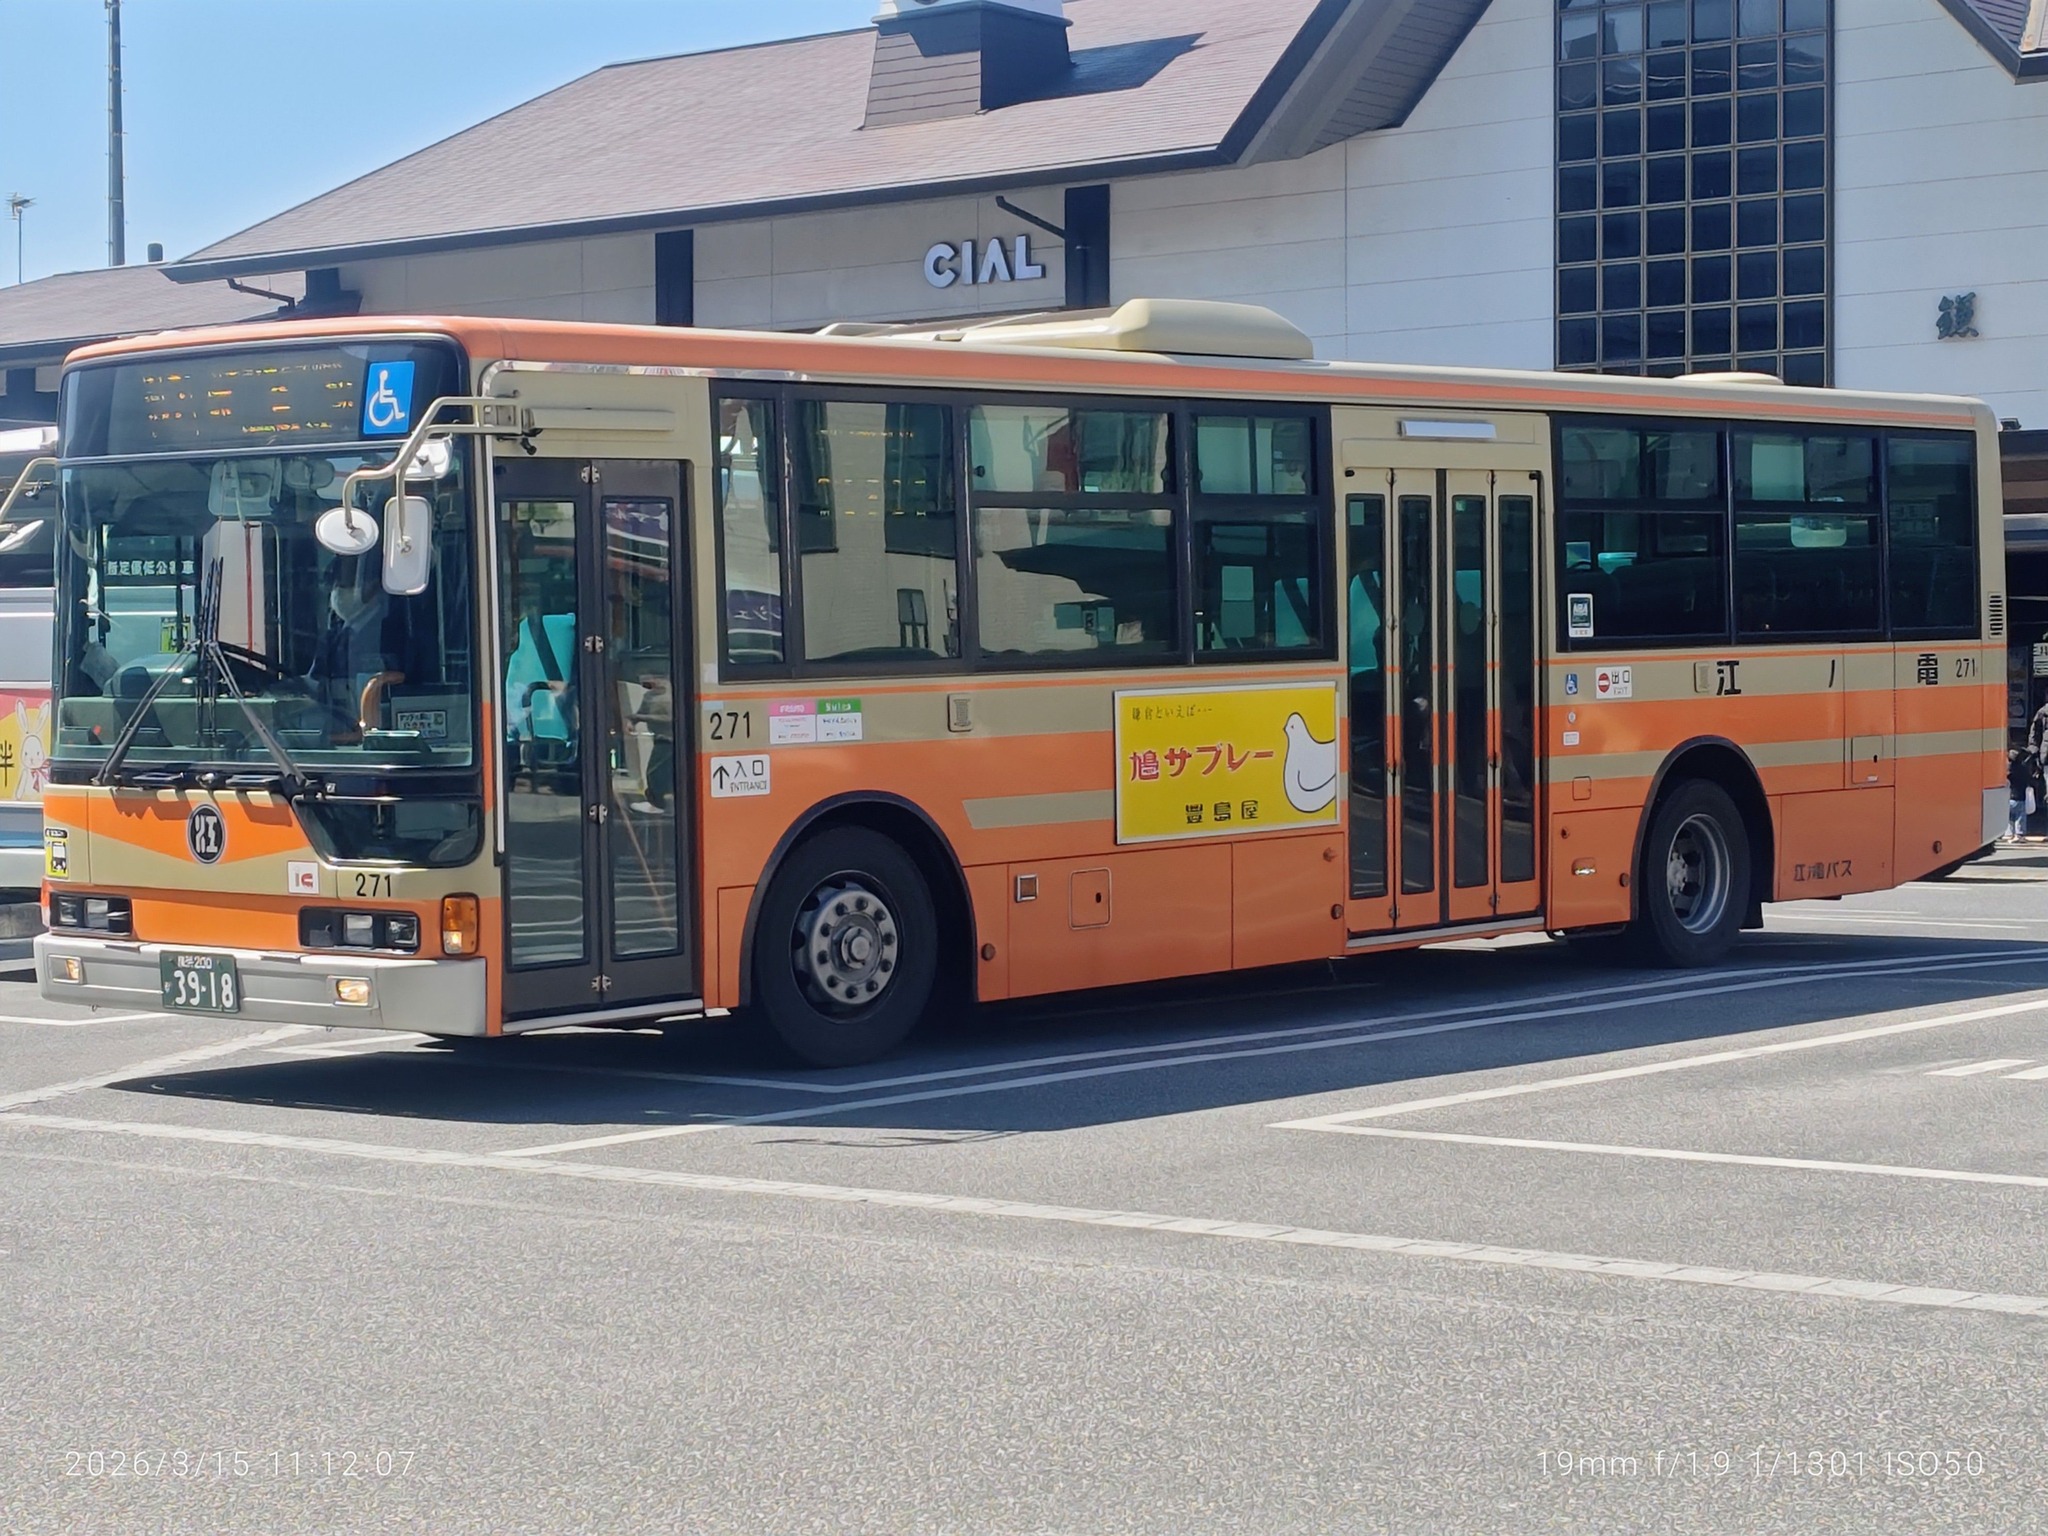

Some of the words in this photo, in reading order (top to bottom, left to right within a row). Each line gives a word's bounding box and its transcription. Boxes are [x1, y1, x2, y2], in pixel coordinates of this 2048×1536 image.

[923, 234, 1045, 288] CIAL
[1955, 657, 1977, 679] 271
[710, 711, 750, 741] 271
[734, 759, 764, 779] 入口
[1129, 742, 1274, 782] 鳩サブレー
[730, 779, 768, 793] ENTRANCE
[355, 872, 392, 898] 271
